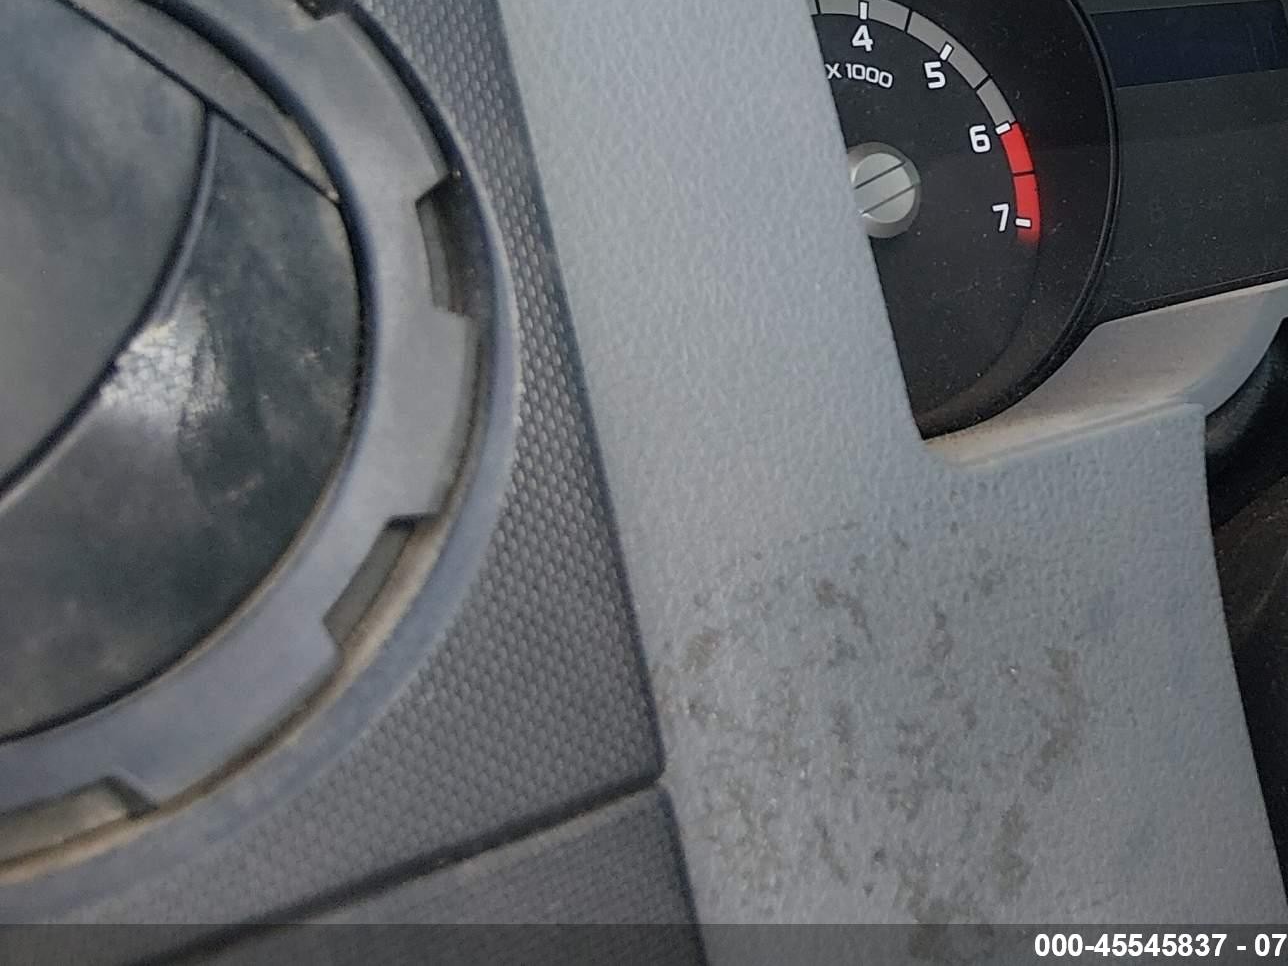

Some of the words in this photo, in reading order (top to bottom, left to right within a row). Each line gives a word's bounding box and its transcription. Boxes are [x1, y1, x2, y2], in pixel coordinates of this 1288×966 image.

[851, 25, 874, 52] 4
[924, 61, 947, 89] 5
[969, 125, 991, 153] 6
[992, 203, 1010, 232] 7
